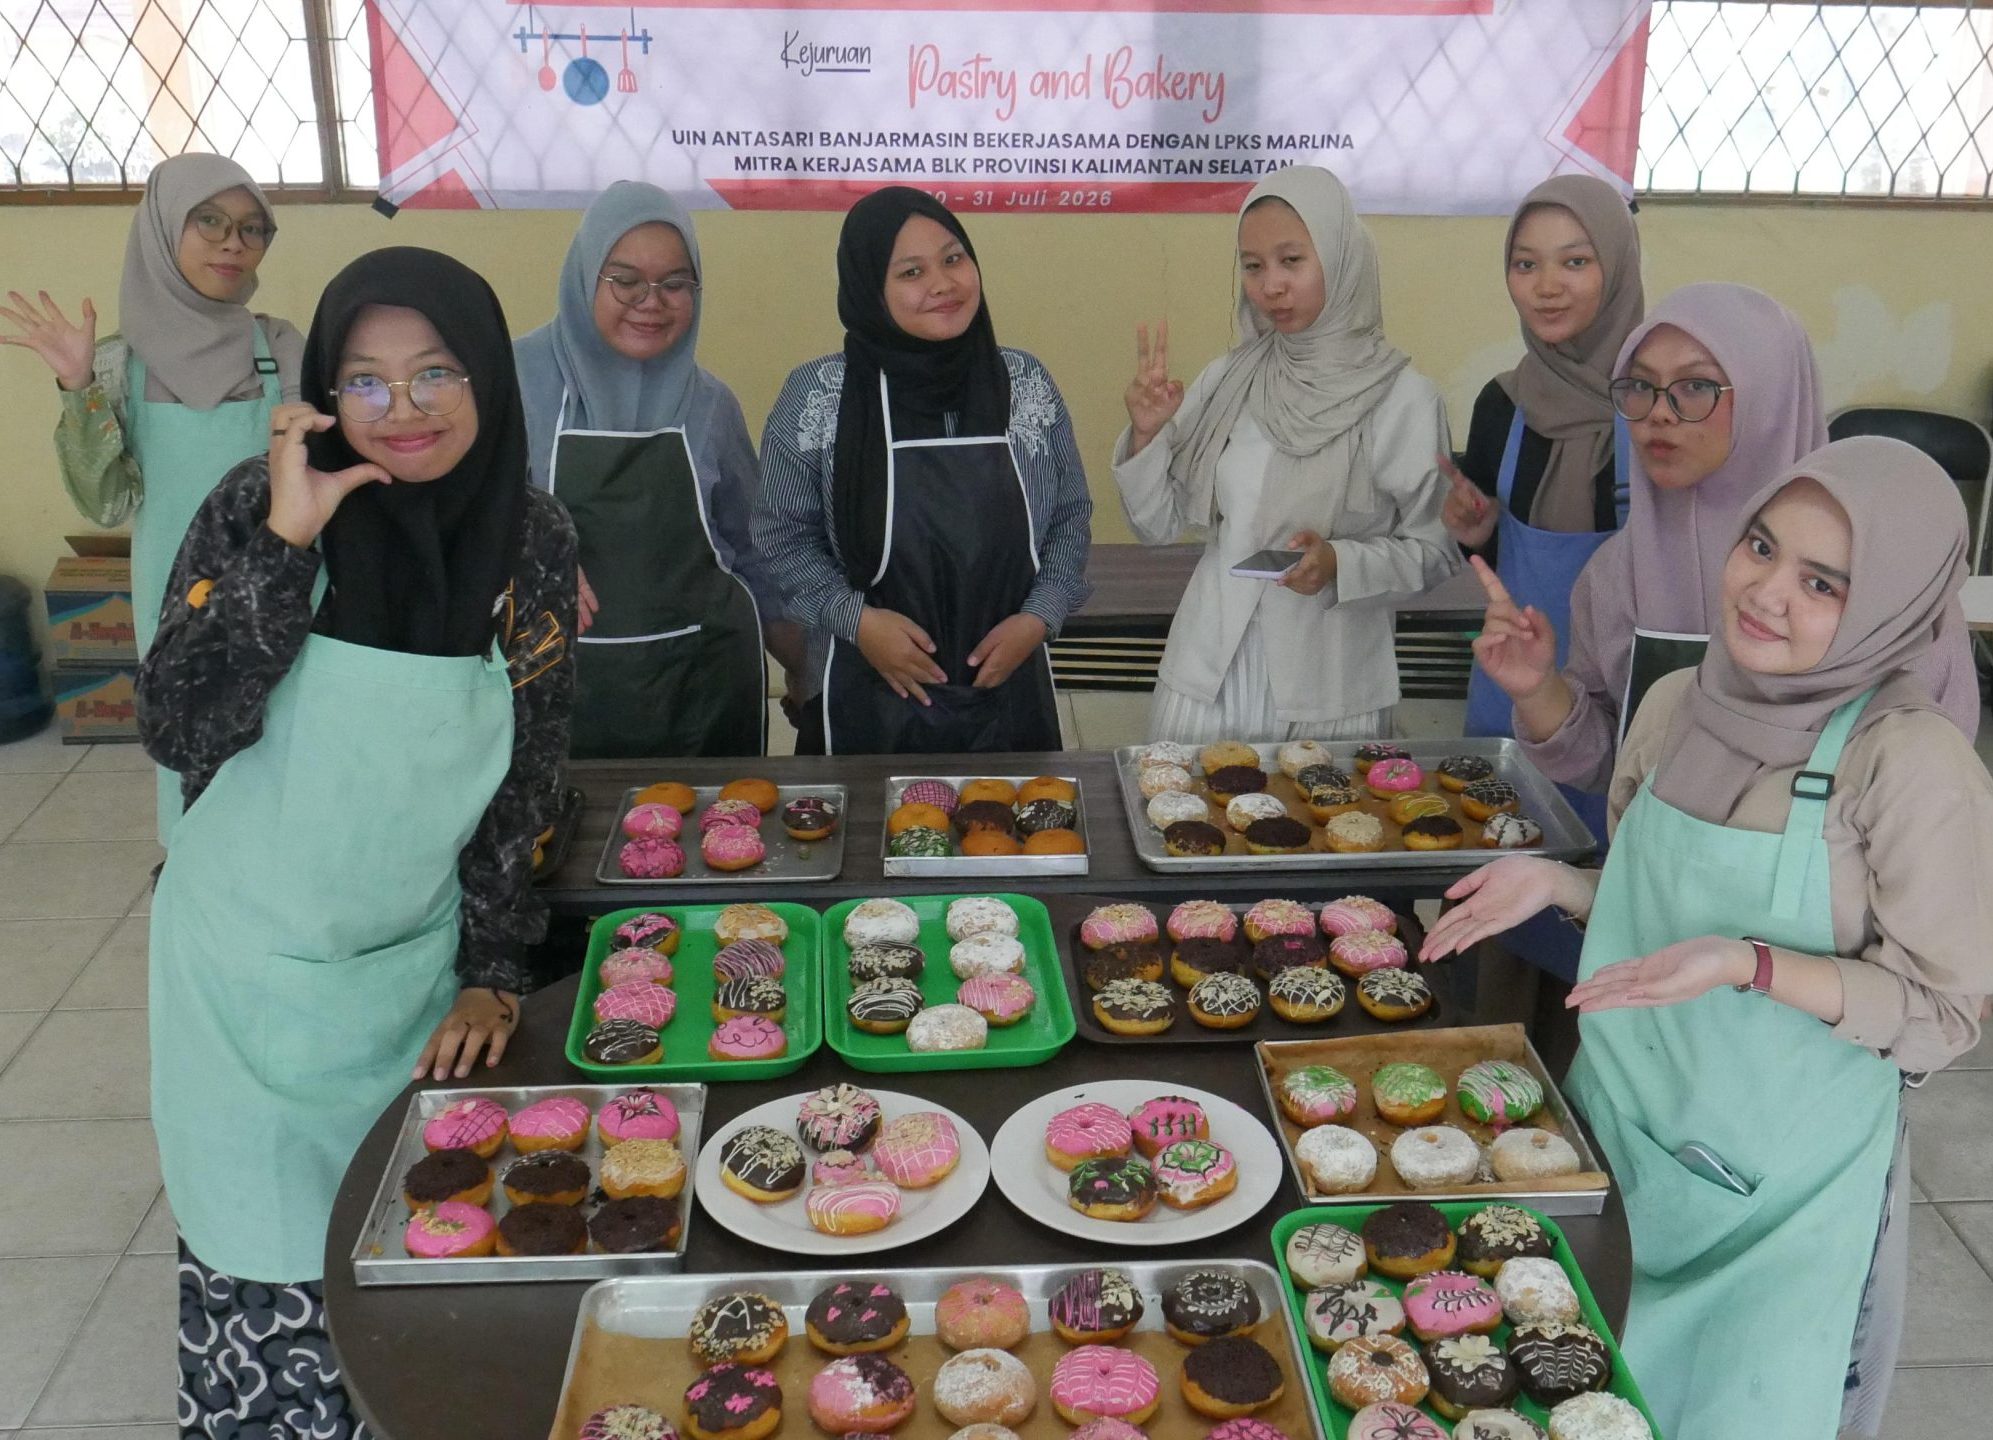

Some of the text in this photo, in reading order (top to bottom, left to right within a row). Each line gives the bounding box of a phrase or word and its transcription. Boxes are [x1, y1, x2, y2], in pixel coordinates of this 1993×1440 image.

[780, 30, 1225, 124] Kejuruan Pastry and Bakery
[672, 129, 1355, 150] UIN ANTASARI BANJARMASIN BEKERJASAMA DENGAN LPKS MARLINA
[734, 156, 797, 172] MITRA
[802, 157, 927, 173] KERJASAMA
[931, 157, 967, 173] BLK
[972, 158, 1066, 174] PROVINSI
[1071, 158, 1203, 175] KALIMANTAN
[972, 190, 994, 206] 31
[1005, 189, 1048, 206] Juli
[1058, 190, 1113, 206] 2026
